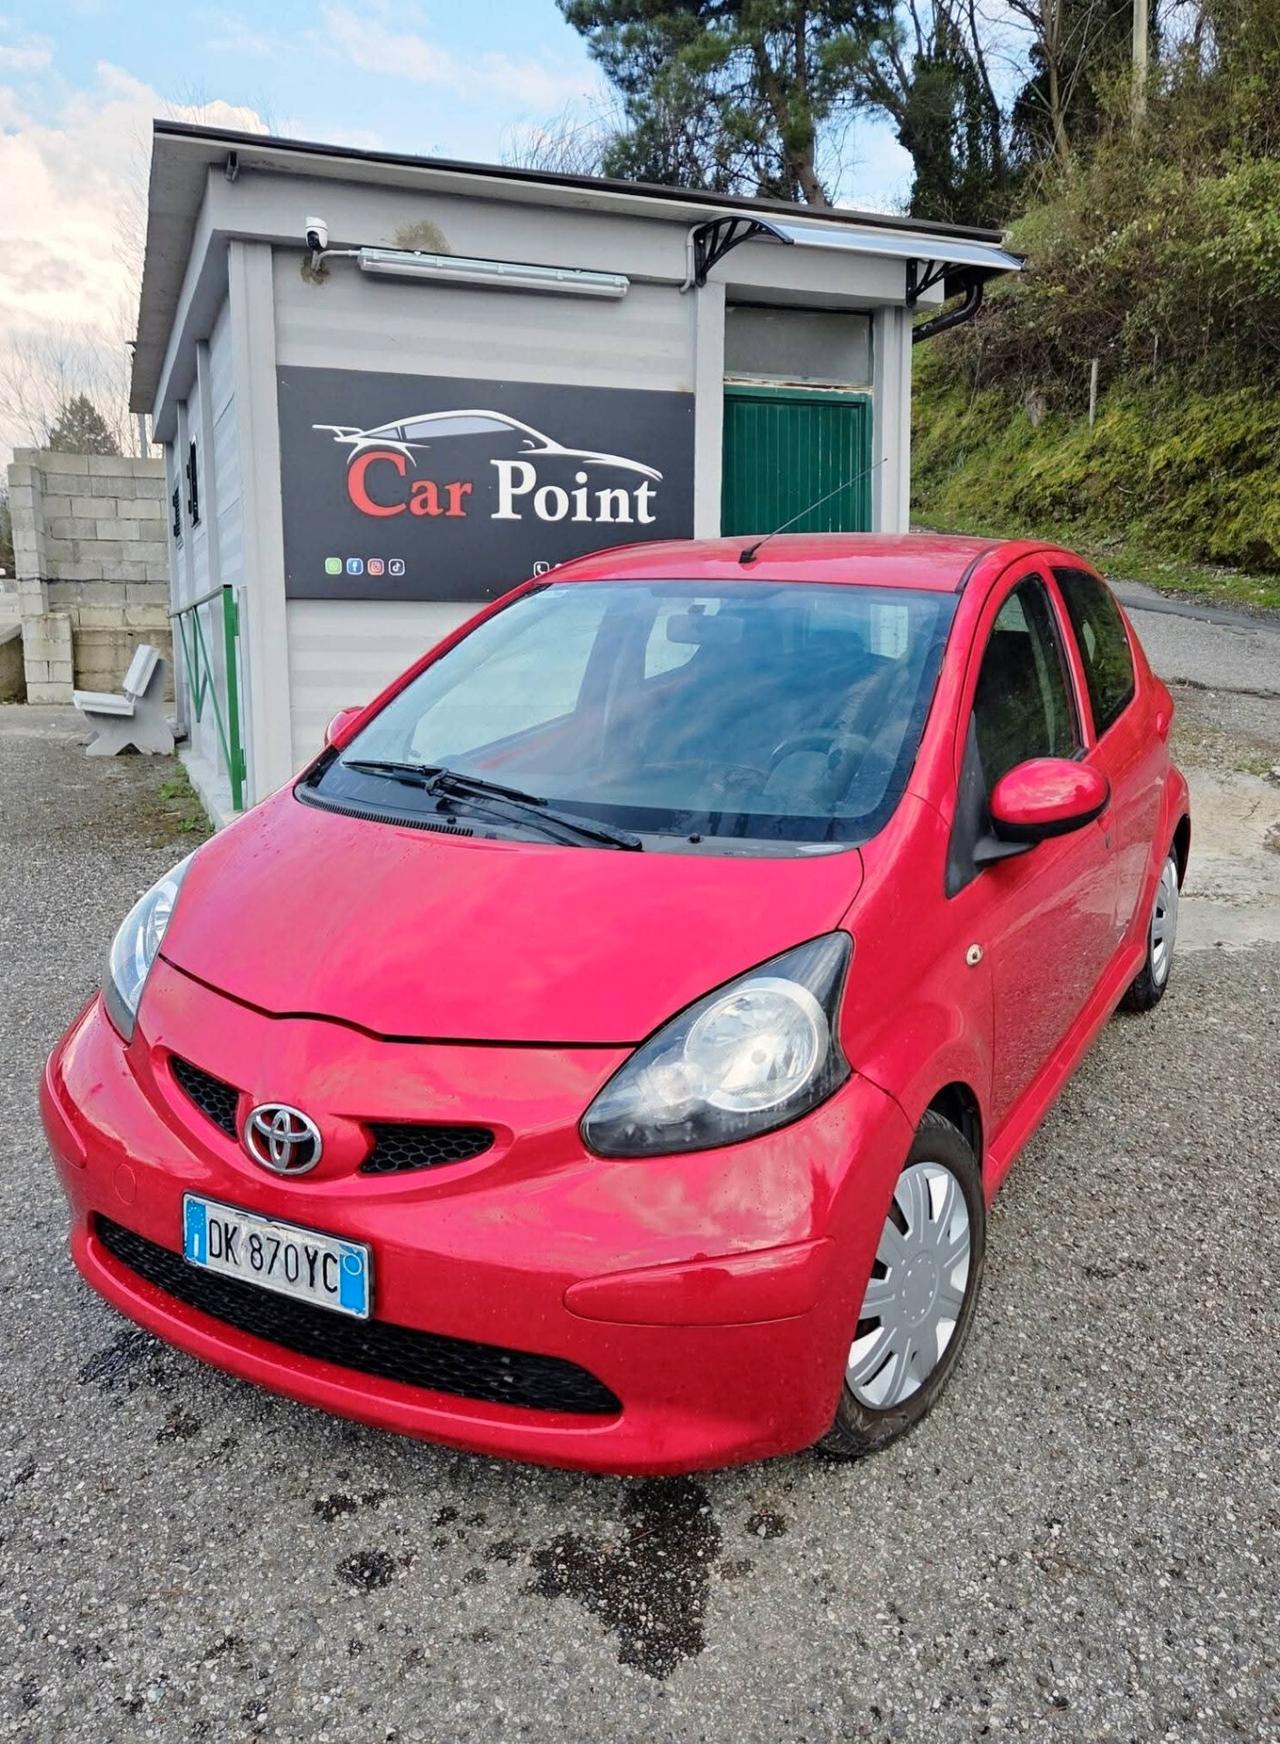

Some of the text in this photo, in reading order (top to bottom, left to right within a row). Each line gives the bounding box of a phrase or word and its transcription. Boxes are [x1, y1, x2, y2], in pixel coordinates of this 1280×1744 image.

[347, 451, 656, 524] Car Point
[209, 1219, 239, 1265] DK
[249, 1233, 338, 1293] 870YC
